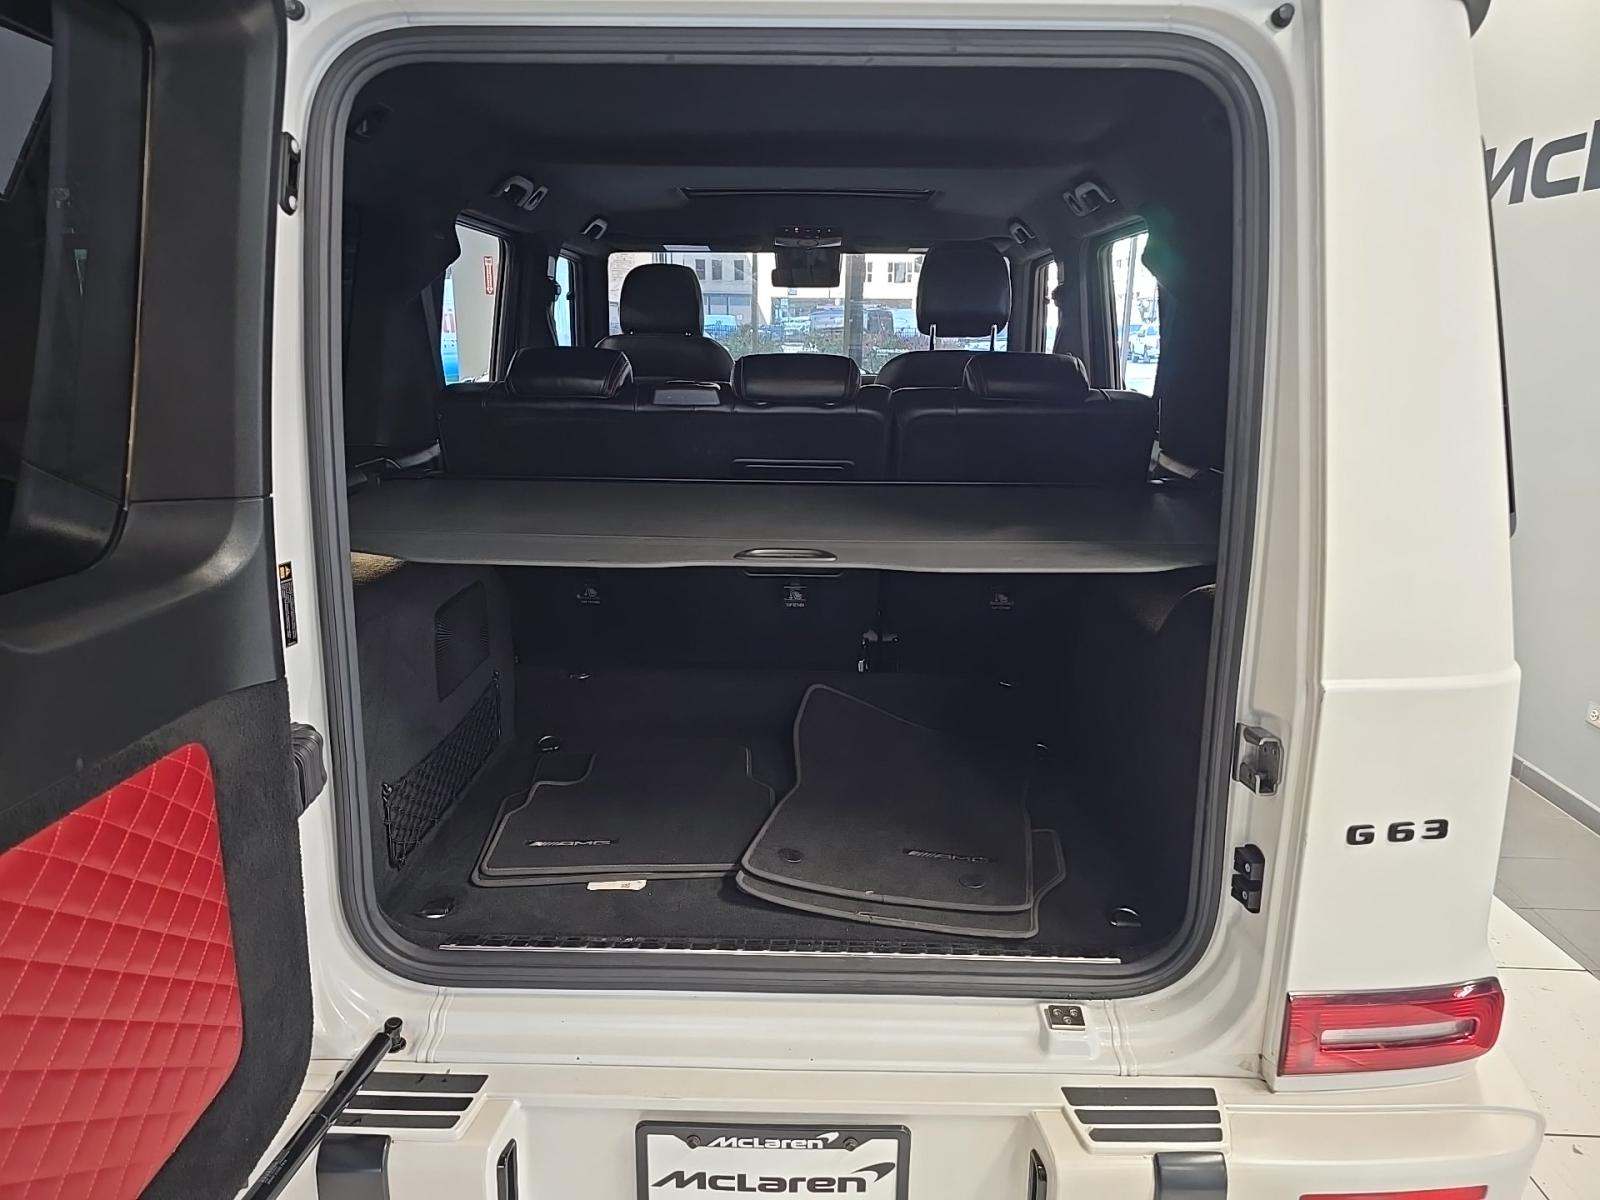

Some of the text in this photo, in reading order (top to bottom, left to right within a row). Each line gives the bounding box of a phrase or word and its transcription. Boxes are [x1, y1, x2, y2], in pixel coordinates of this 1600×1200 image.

[1346, 819, 1449, 846] G 63
[706, 1136, 823, 1149] McLaren
[650, 1170, 867, 1193] McLaren
